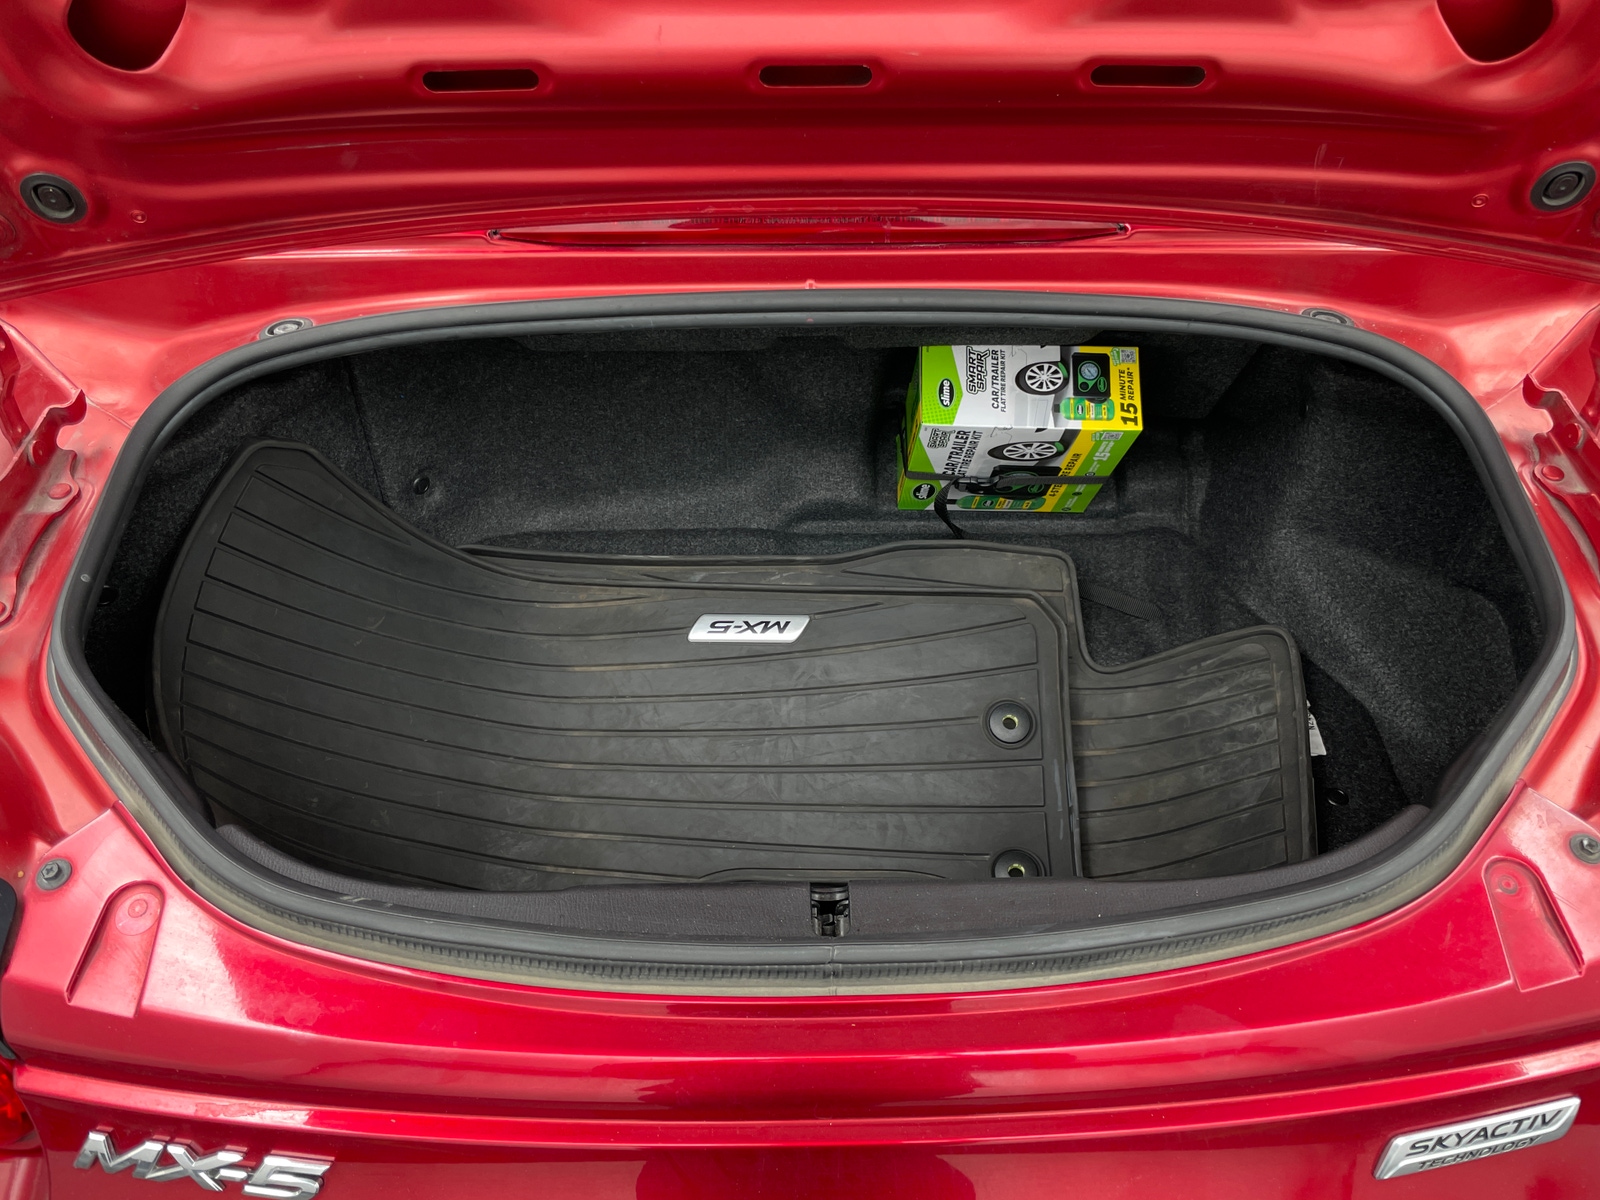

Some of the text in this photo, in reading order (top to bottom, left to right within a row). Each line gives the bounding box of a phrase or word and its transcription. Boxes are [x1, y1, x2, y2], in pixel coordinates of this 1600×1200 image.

[967, 346, 977, 393] SMART
[976, 349, 988, 390] SPAIR
[991, 349, 1000, 409] CAR/TRAILER
[940, 380, 951, 407] slime
[1120, 402, 1138, 426] 15
[707, 620, 791, 634] MX-5
[1405, 1110, 1562, 1157] SKYACTIV
[1418, 1136, 1542, 1171] TECHNOLOGY
[73, 1131, 332, 1200] MX-5
